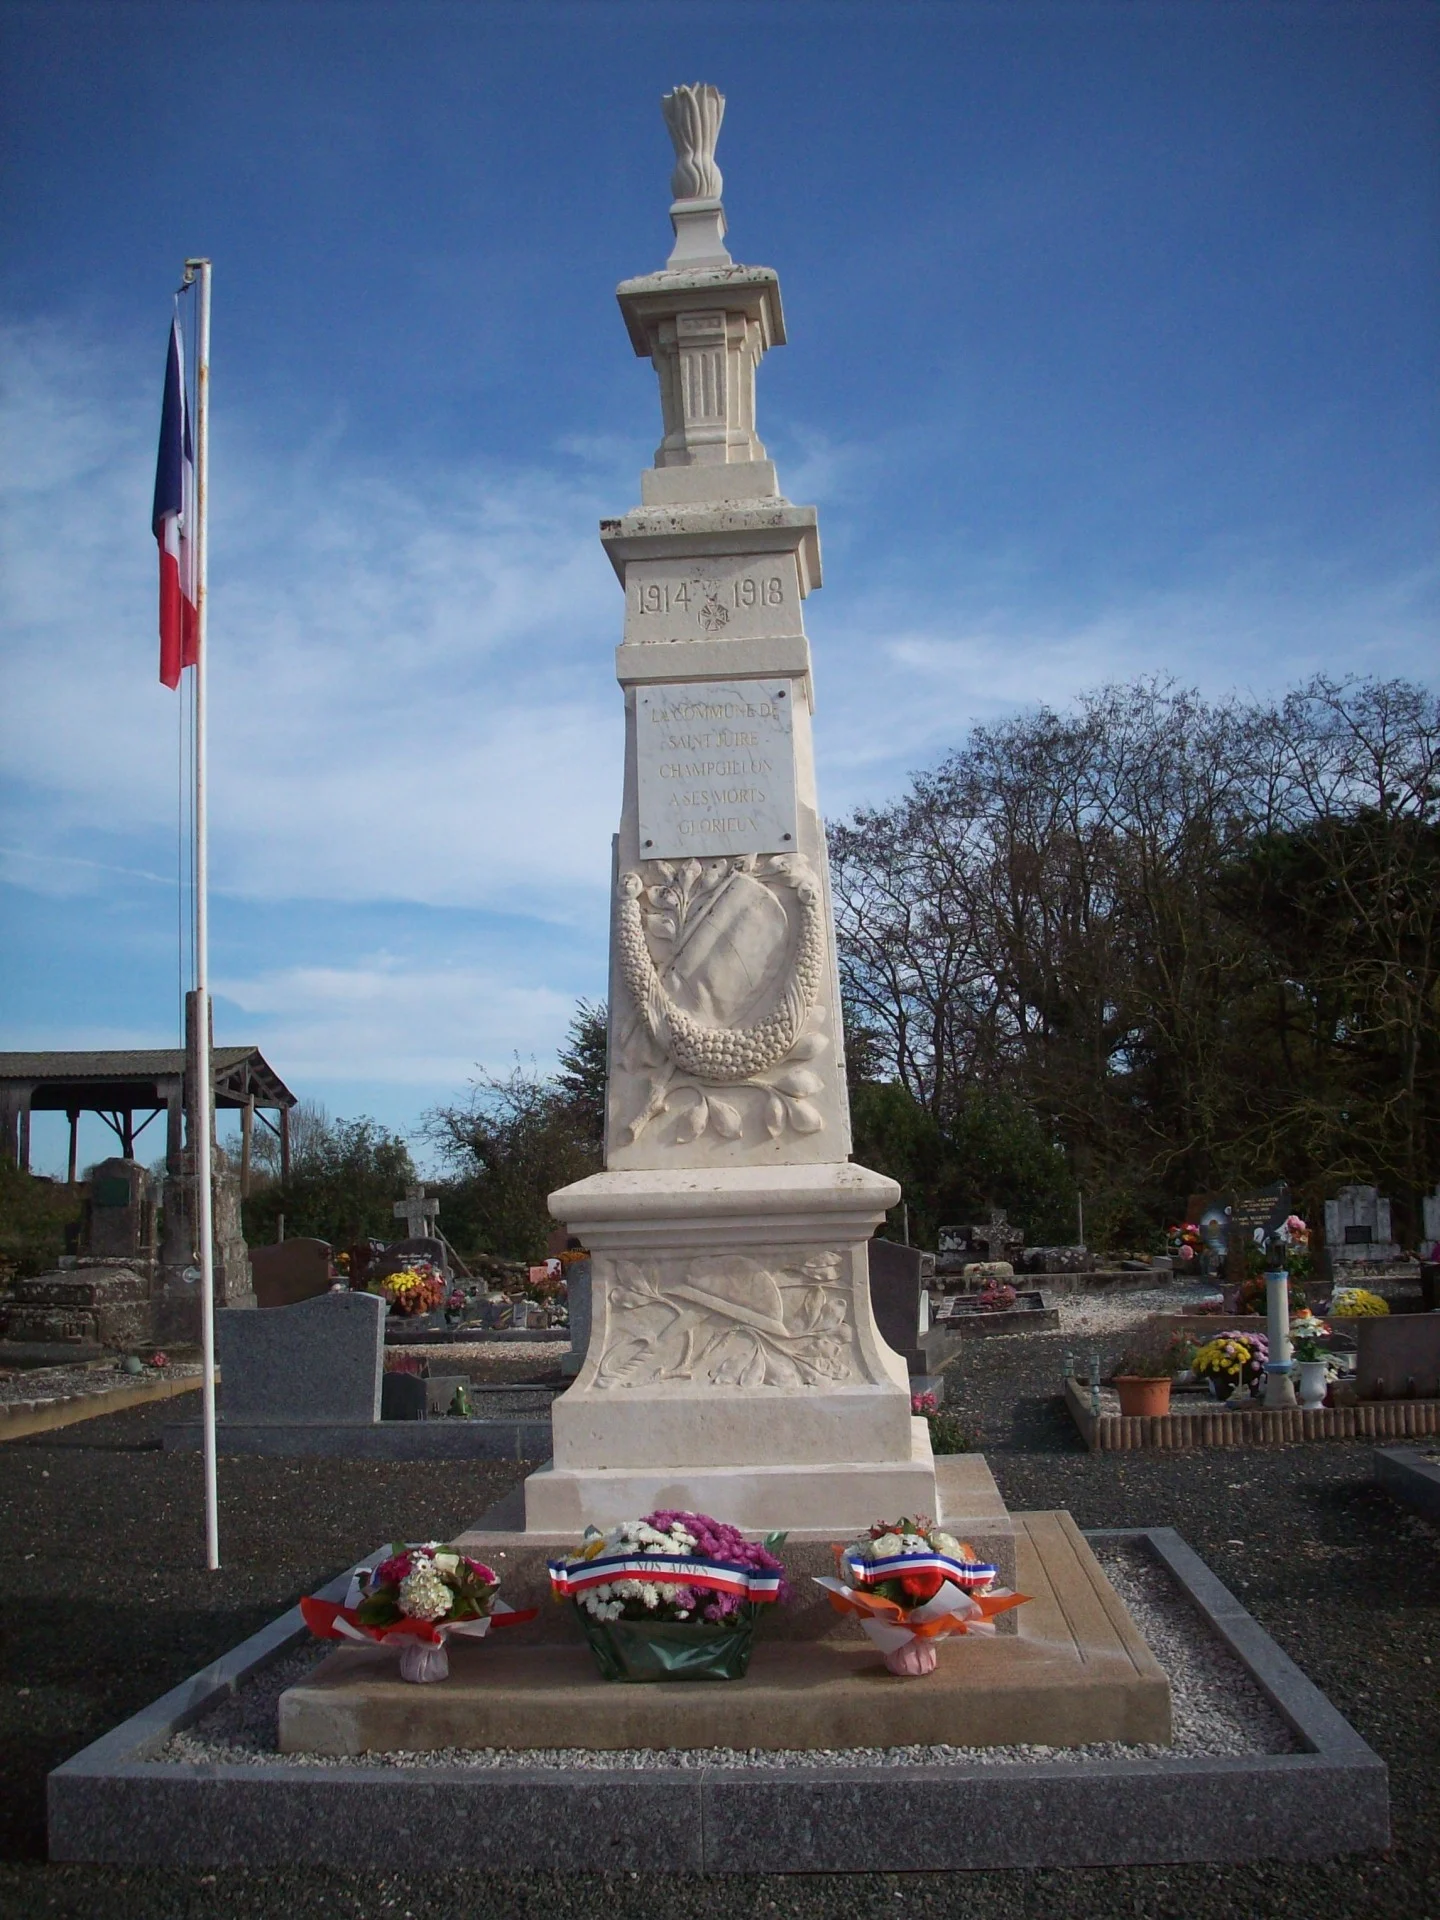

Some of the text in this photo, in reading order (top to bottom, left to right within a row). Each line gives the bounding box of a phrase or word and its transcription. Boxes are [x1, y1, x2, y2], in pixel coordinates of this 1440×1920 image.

[639, 577, 784, 614] 1914 1918
[652, 702, 779, 723] LA COMMUNE DE
[668, 731, 759, 749] SAINT JUIRE
[659, 759, 773, 779] CHAMPGILLON
[682, 790, 709, 806] SES
[712, 788, 766, 804] MORTS
[677, 817, 759, 835] GLORIEUX
[635, 1560, 661, 1572] NOS
